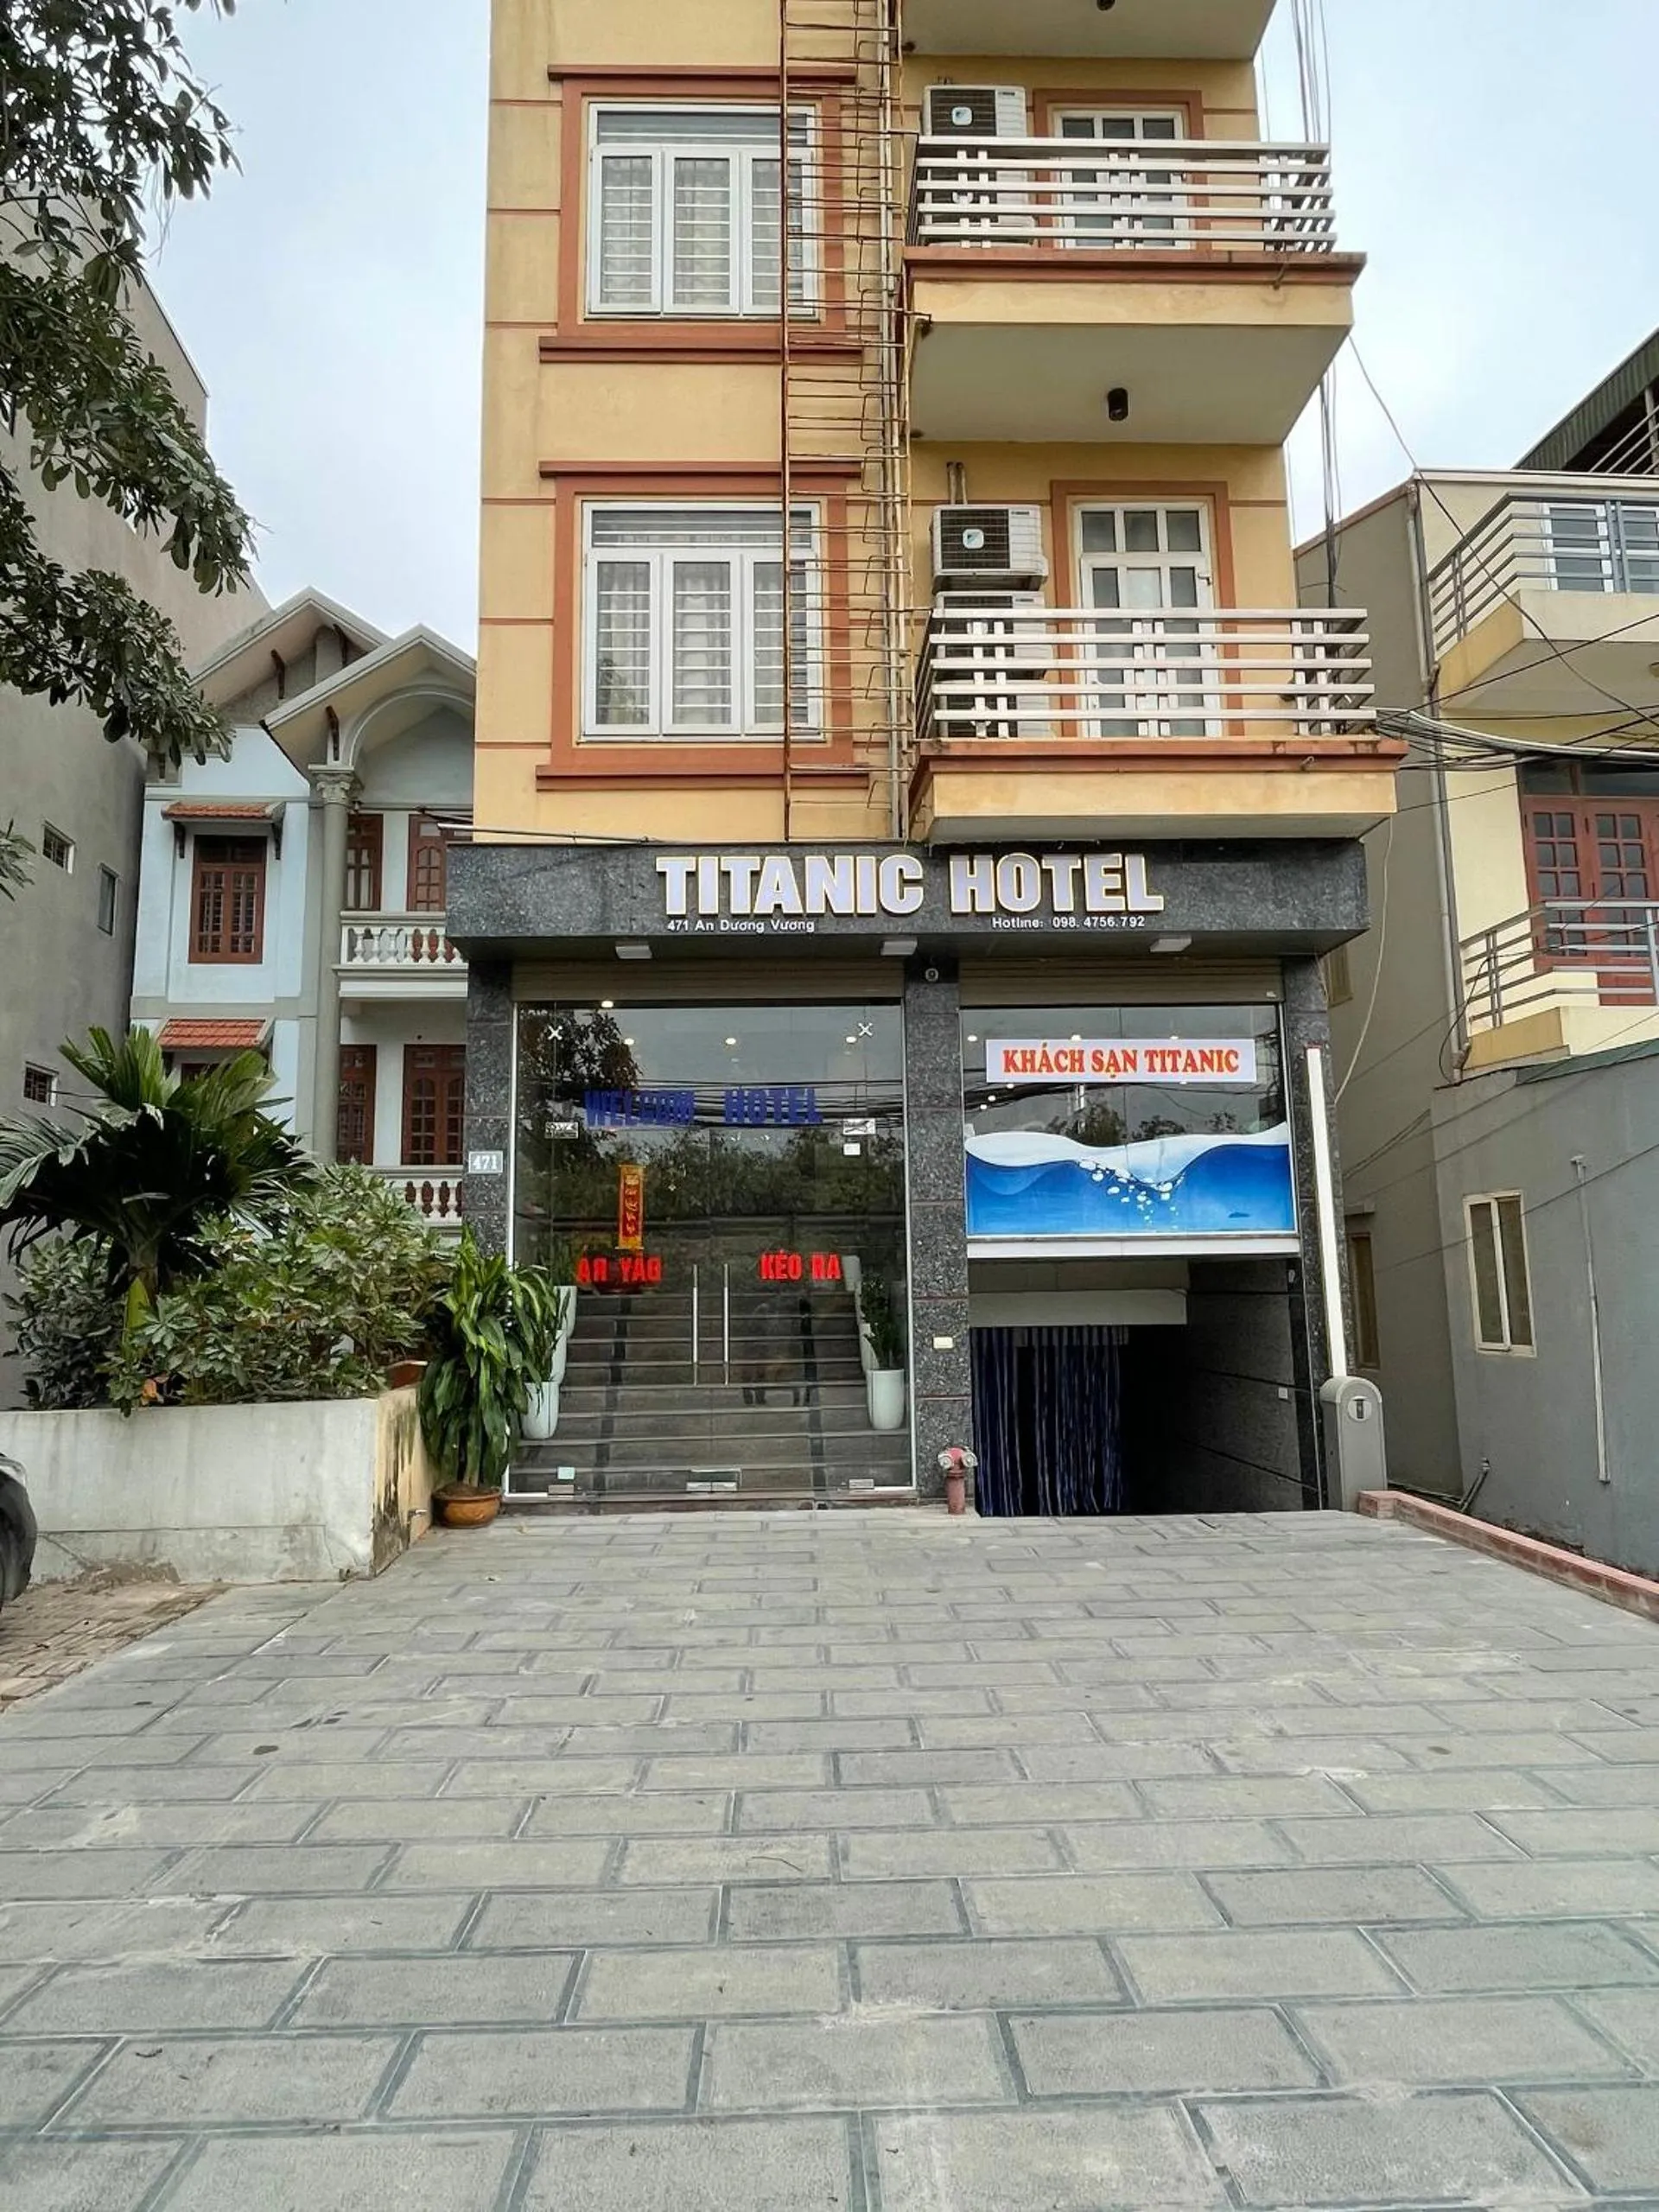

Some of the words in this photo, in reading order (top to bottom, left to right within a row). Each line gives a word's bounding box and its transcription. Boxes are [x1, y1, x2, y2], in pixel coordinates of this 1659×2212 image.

[655, 854, 925, 916] TITANIC
[949, 852, 1166, 913] HOTEL
[667, 919, 689, 931] 471
[695, 919, 715, 931] An
[720, 919, 765, 933] Dương
[771, 919, 815, 932] Vương
[1002, 1042, 1085, 1073] KHÁCH
[1090, 1049, 1138, 1078] SẠN
[1144, 1049, 1239, 1073] TITANIC
[724, 1087, 823, 1123] HOTEL
[473, 1154, 498, 1170] 471
